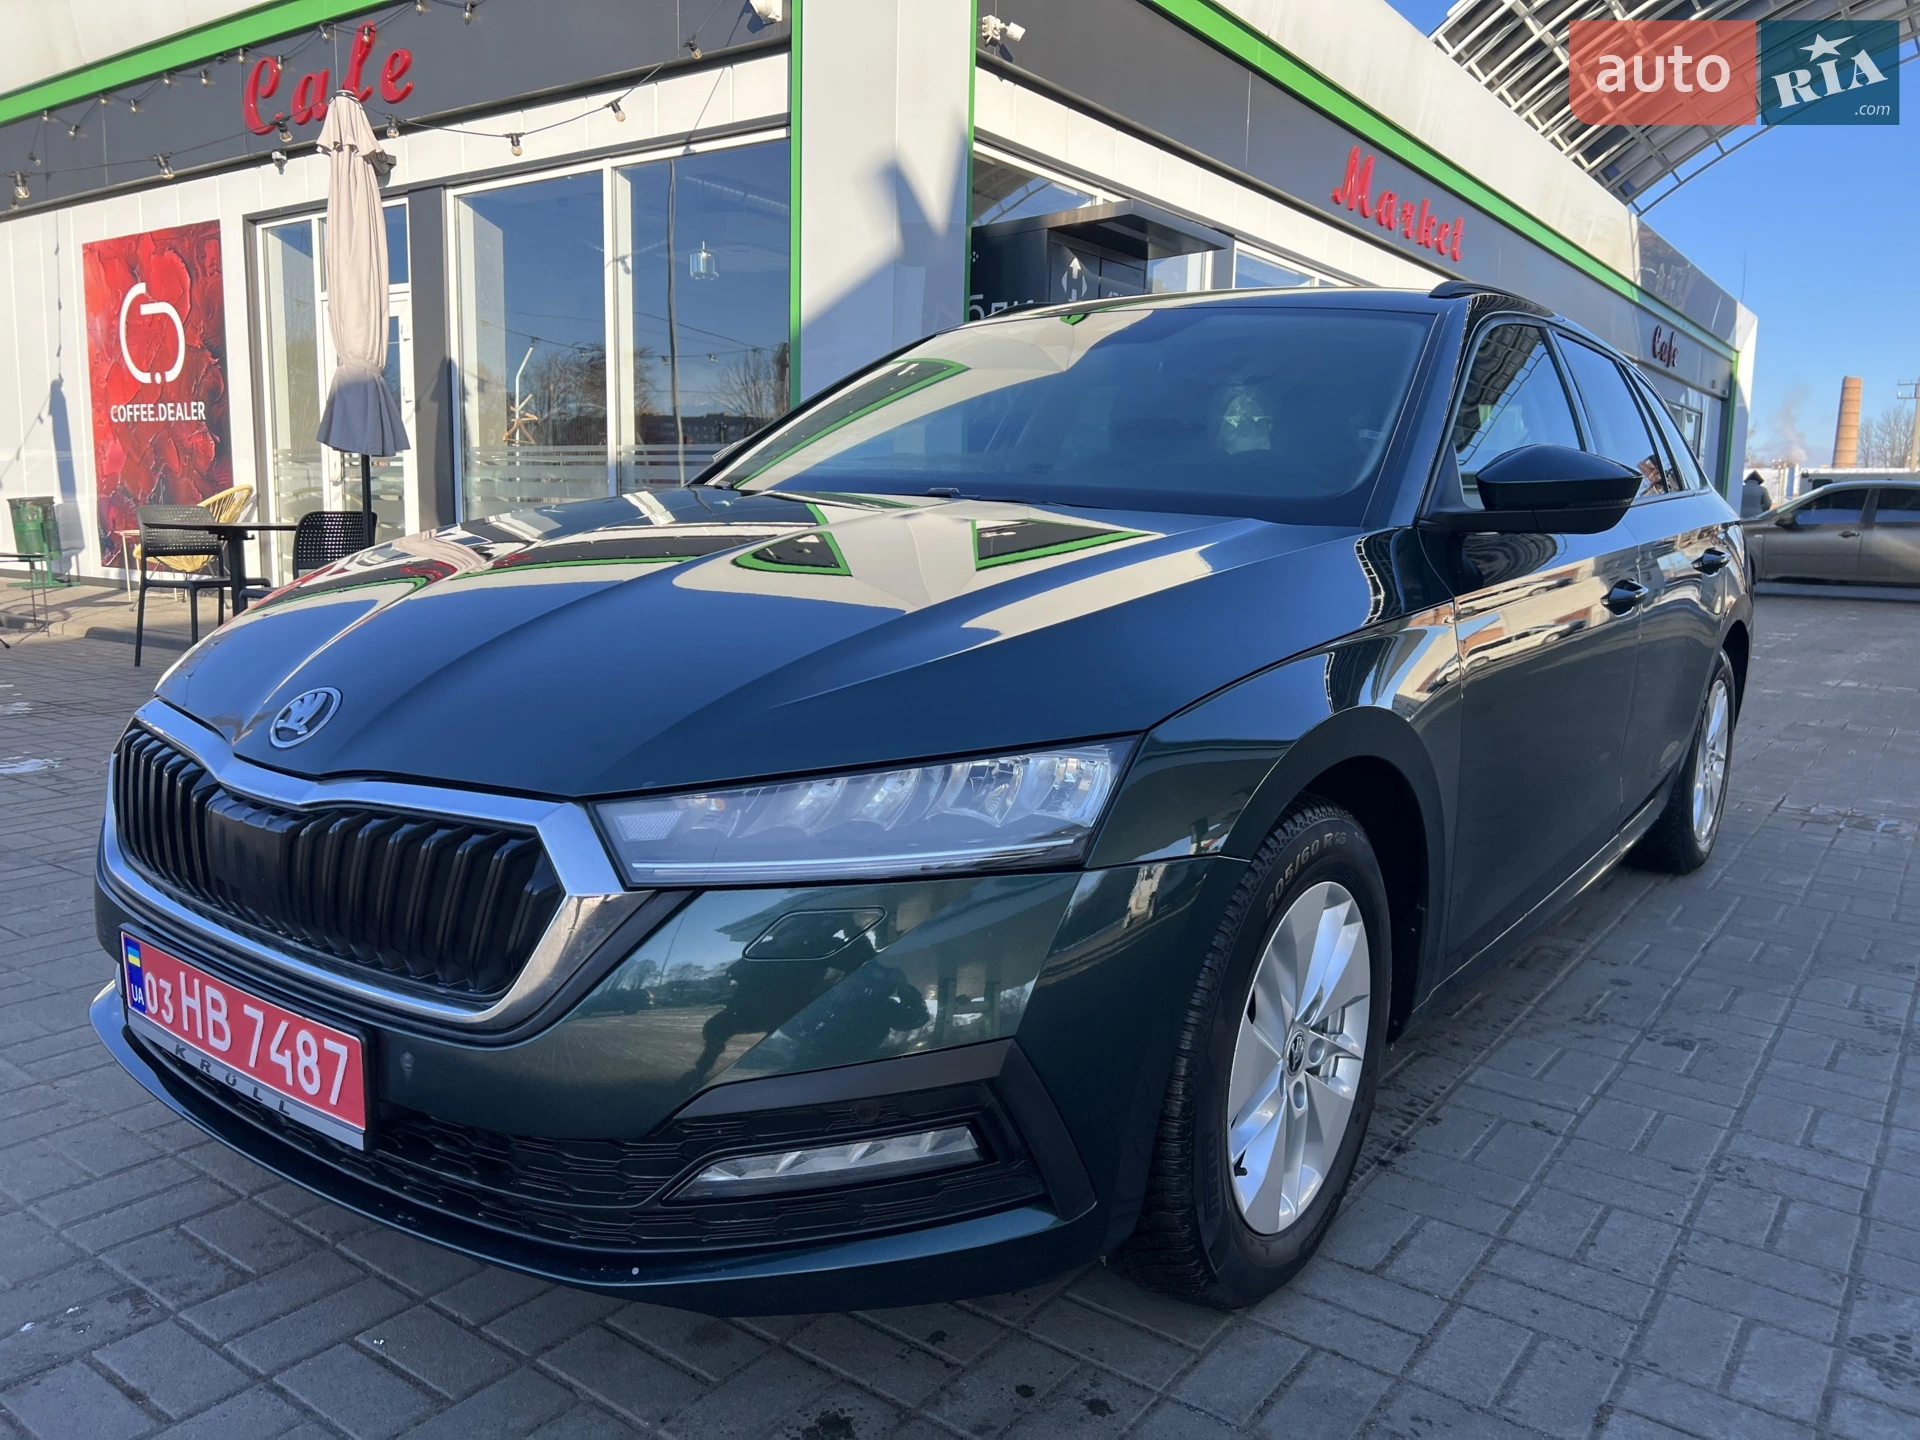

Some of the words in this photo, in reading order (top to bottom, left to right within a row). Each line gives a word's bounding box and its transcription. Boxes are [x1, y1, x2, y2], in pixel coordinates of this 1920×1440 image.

[1331, 145, 1465, 262] Market
[1652, 325, 1679, 368] Cafe
[110, 401, 207, 423] COFFEE.DEALER
[1266, 839, 1319, 919] 205/60
[131, 983, 145, 1006] UA
[144, 972, 174, 1024] 03
[179, 971, 232, 1052] HB
[243, 1004, 348, 1106] 7487
[175, 1044, 290, 1116] KRÜLL
